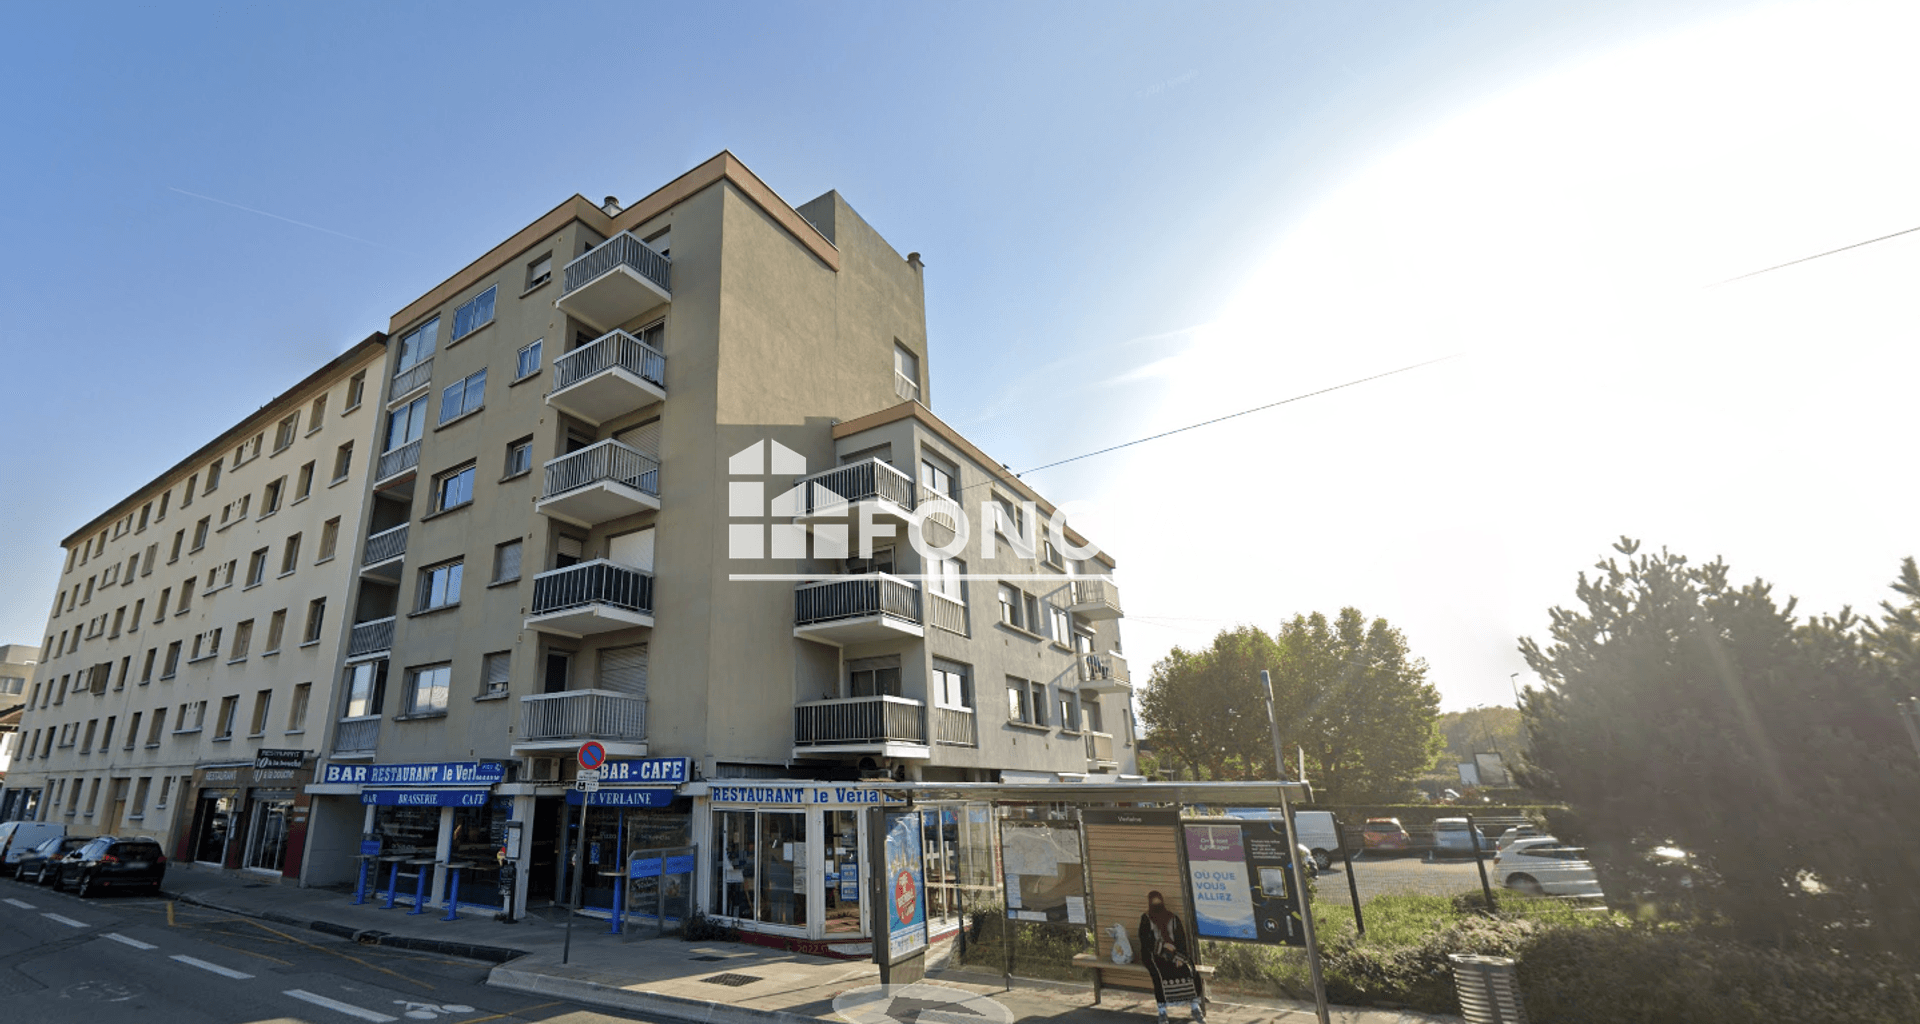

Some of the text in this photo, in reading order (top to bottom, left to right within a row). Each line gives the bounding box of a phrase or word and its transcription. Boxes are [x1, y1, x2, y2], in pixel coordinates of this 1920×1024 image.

[327, 765, 367, 782] BAR
[370, 765, 438, 782] RESTAURANT
[442, 764, 453, 781] le
[600, 761, 630, 780] BAR
[641, 759, 683, 780] CAFE
[363, 793, 378, 804] BAR
[398, 793, 439, 805] BRASSERIE
[599, 792, 652, 805] VERLAINE
[713, 787, 804, 803] RESTAURANT
[813, 787, 829, 804] le
[1212, 871, 1236, 881] QUE
[1195, 882, 1227, 891] VOUS
[1197, 892, 1232, 902] ALLIEZ
